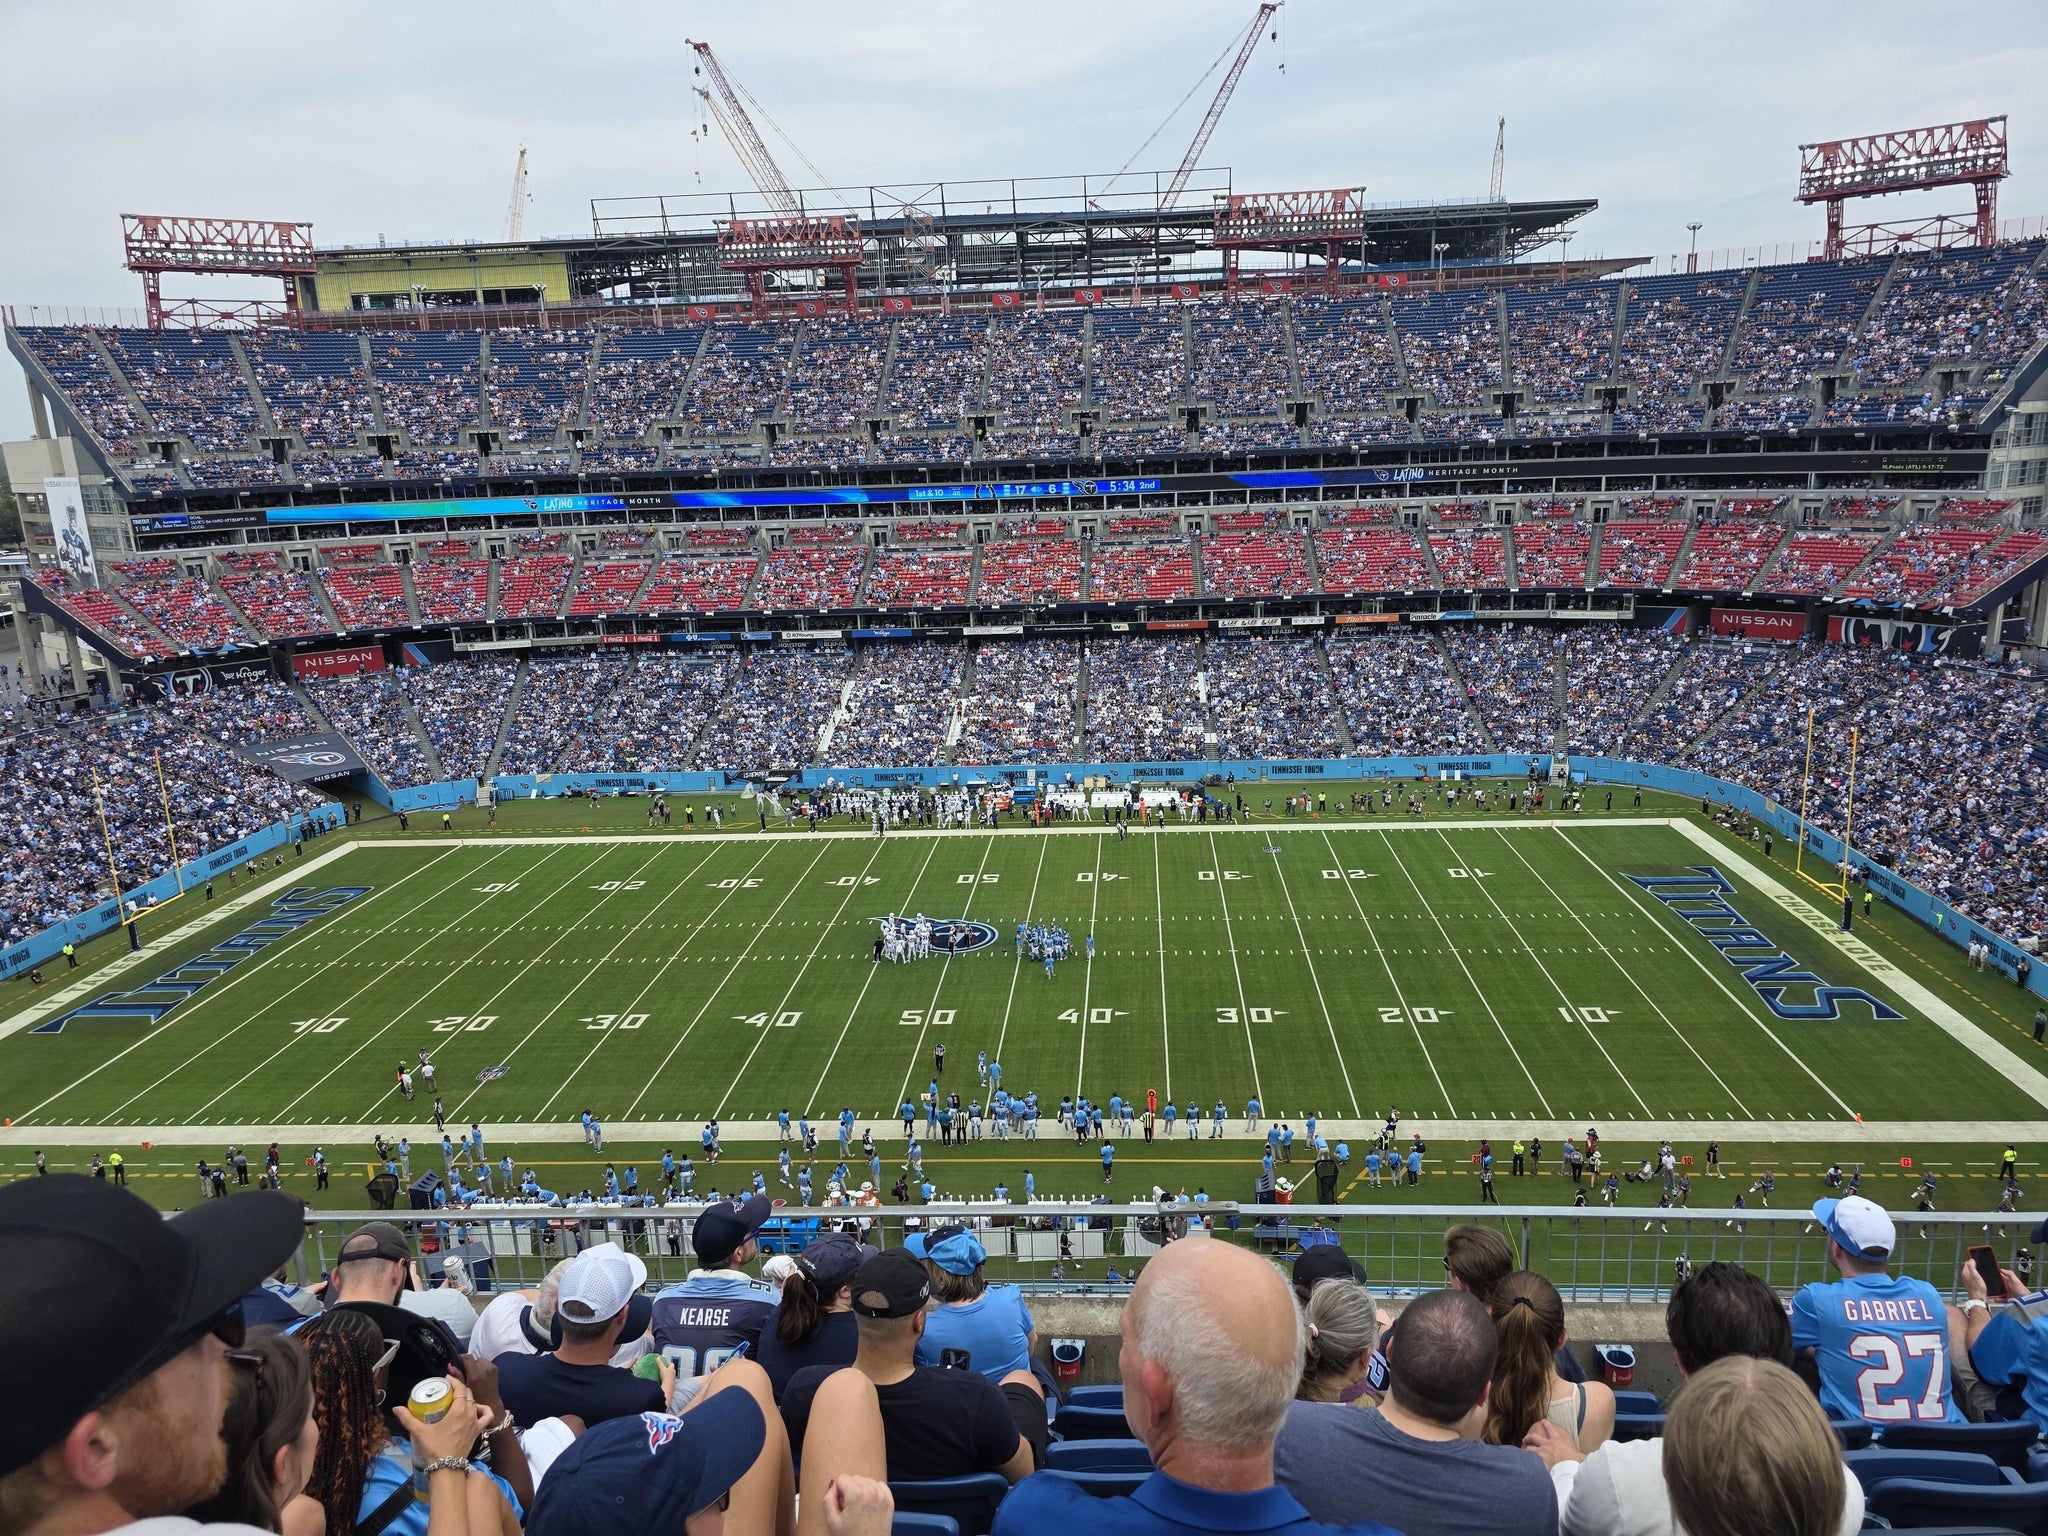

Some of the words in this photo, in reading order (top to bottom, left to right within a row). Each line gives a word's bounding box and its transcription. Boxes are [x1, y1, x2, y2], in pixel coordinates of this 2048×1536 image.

[1393, 467, 1424, 481] LATINO
[1428, 468, 1477, 476] HERITAGE
[915, 489, 926, 497] 1st
[927, 489, 935, 497] &
[1015, 485, 1026, 495] 17
[1048, 484, 1057, 494] 6
[1110, 480, 1135, 491] 5:34
[1139, 481, 1155, 489] 2nd
[544, 498, 573, 511] LATINO
[578, 498, 624, 506] HERITAGE
[629, 497, 661, 505] MONTH
[1722, 614, 1793, 627] NISSAN
[305, 652, 372, 667] NISSAN
[236, 666, 267, 682] Kroger
[256, 741, 328, 757] NISSAN
[1133, 767, 1163, 777] TENNESSEE
[1165, 767, 1184, 776] TOUGH
[1271, 765, 1302, 774] TENNESSEE
[1304, 765, 1324, 773] TOUGH
[1438, 762, 1469, 771] TENNESSEE
[1472, 761, 1491, 770] TOUGH
[314, 771, 350, 782] NISSAN
[595, 778, 625, 788] TENNESSEE
[626, 778, 644, 787] TOUGH
[1811, 834, 1824, 850] TOUGH
[209, 852, 233, 871] TENNESSEE
[233, 844, 249, 860] TOUGH
[1890, 880, 1905, 900] TOUGH
[1774, 894, 1847, 935] CHOOSE
[1835, 940, 1894, 972] LOVE
[1618, 866, 1908, 1021] TITANS
[8, 947, 31, 967] TOUGH
[27, 886, 375, 1034] TITANS
[32, 999, 65, 1012] IT
[68, 955, 144, 993] TAKES
[148, 931, 190, 951] ALL
[190, 917, 216, 933] OF
[220, 901, 249, 914] US
[585, 1013, 651, 1030] 30
[744, 1011, 804, 1027] 40
[899, 1010, 957, 1025] 50
[1057, 1008, 1113, 1023] 40
[1216, 1007, 1274, 1022] 30
[1378, 1006, 1440, 1022] 20
[1558, 1006, 1610, 1022] 10
[294, 1017, 351, 1034] 10
[433, 1016, 500, 1032] 20
[142, 1141, 150, 1149] 10
[306, 1158, 314, 1166] 20
[1472, 1155, 1481, 1163] 20
[1683, 1156, 1691, 1164] 10
[1903, 1159, 1910, 1167] G
[679, 1307, 731, 1327] KEARSE
[1843, 1298, 1934, 1323] GABRIEL
[1848, 1332, 1945, 1421] 27
